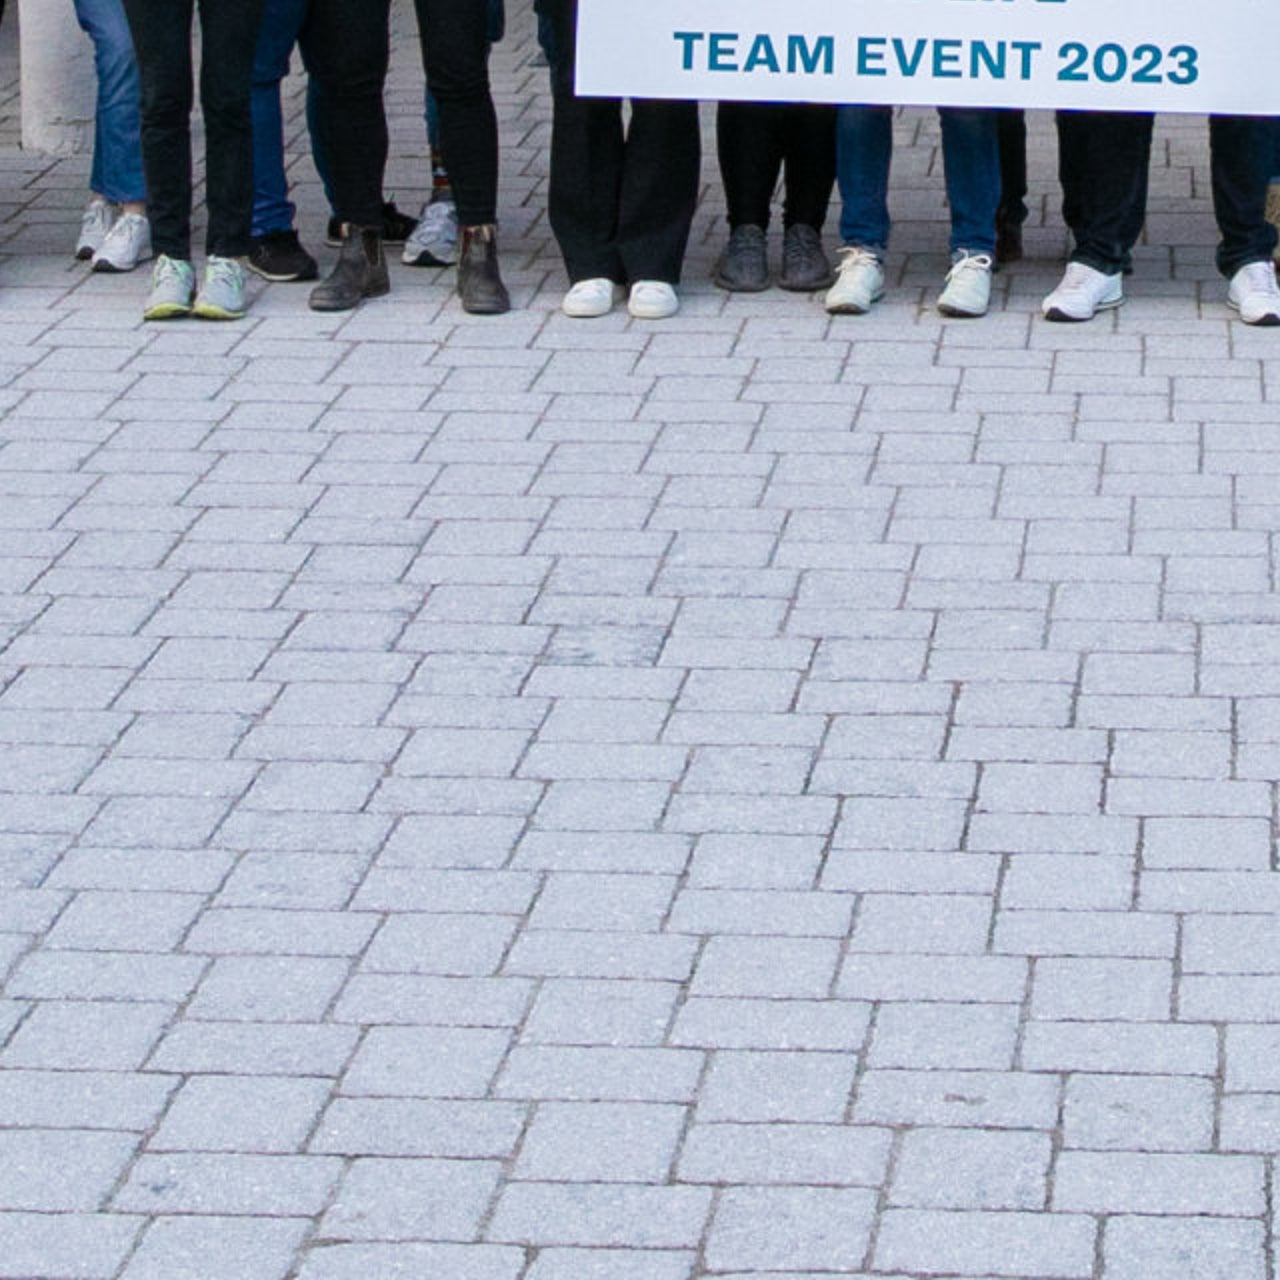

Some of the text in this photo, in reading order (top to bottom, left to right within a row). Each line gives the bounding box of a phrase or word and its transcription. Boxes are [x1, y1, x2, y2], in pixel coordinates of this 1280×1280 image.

[673, 31, 1199, 86] TEAM EVENT 2023
